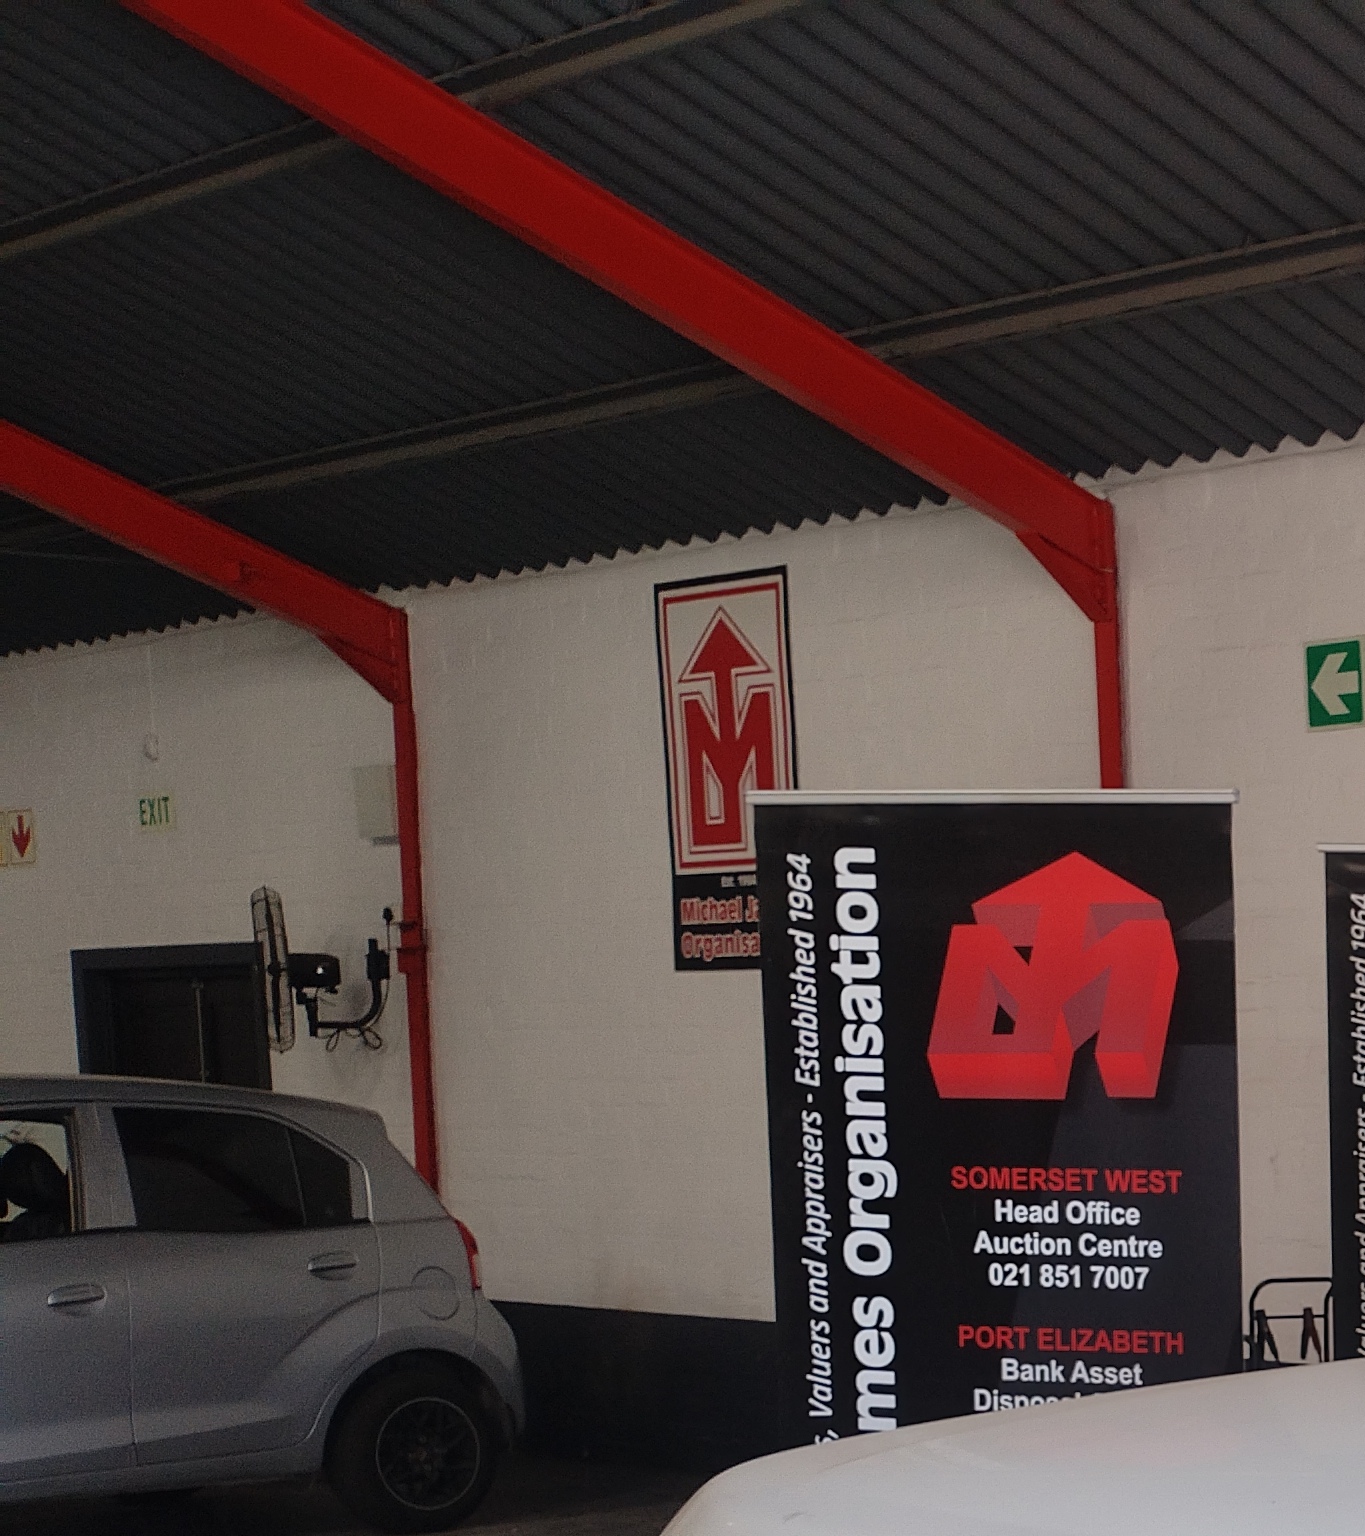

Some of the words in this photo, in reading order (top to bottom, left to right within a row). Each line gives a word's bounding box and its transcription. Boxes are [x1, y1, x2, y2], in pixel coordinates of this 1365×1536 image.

[138, 796, 170, 826] EXIT
[787, 852, 814, 921] 1964
[681, 896, 742, 925] Michael
[681, 929, 760, 962] Organisa
[787, 928, 821, 1087] Established
[830, 846, 898, 1276] Organisation
[797, 1110, 832, 1255] Appraisers
[951, 1165, 1098, 1192] SOMERSET
[1104, 1168, 1182, 1194] WEST
[994, 1198, 1059, 1224] Head
[1065, 1200, 1141, 1226] Office
[973, 1230, 1072, 1257] Auction
[1078, 1232, 1164, 1259] Centre
[801, 1257, 830, 1313] and
[988, 1262, 1031, 1287] 021
[1039, 1264, 1081, 1289] 851
[1089, 1265, 1150, 1290] 7007
[957, 1324, 1030, 1350] PORT
[1036, 1327, 1185, 1355] ELIZABETH
[805, 1319, 833, 1417] Valuers
[852, 1296, 897, 1431] mes
[1001, 1357, 1065, 1383] Bank
[1070, 1360, 1144, 1386] Asset
